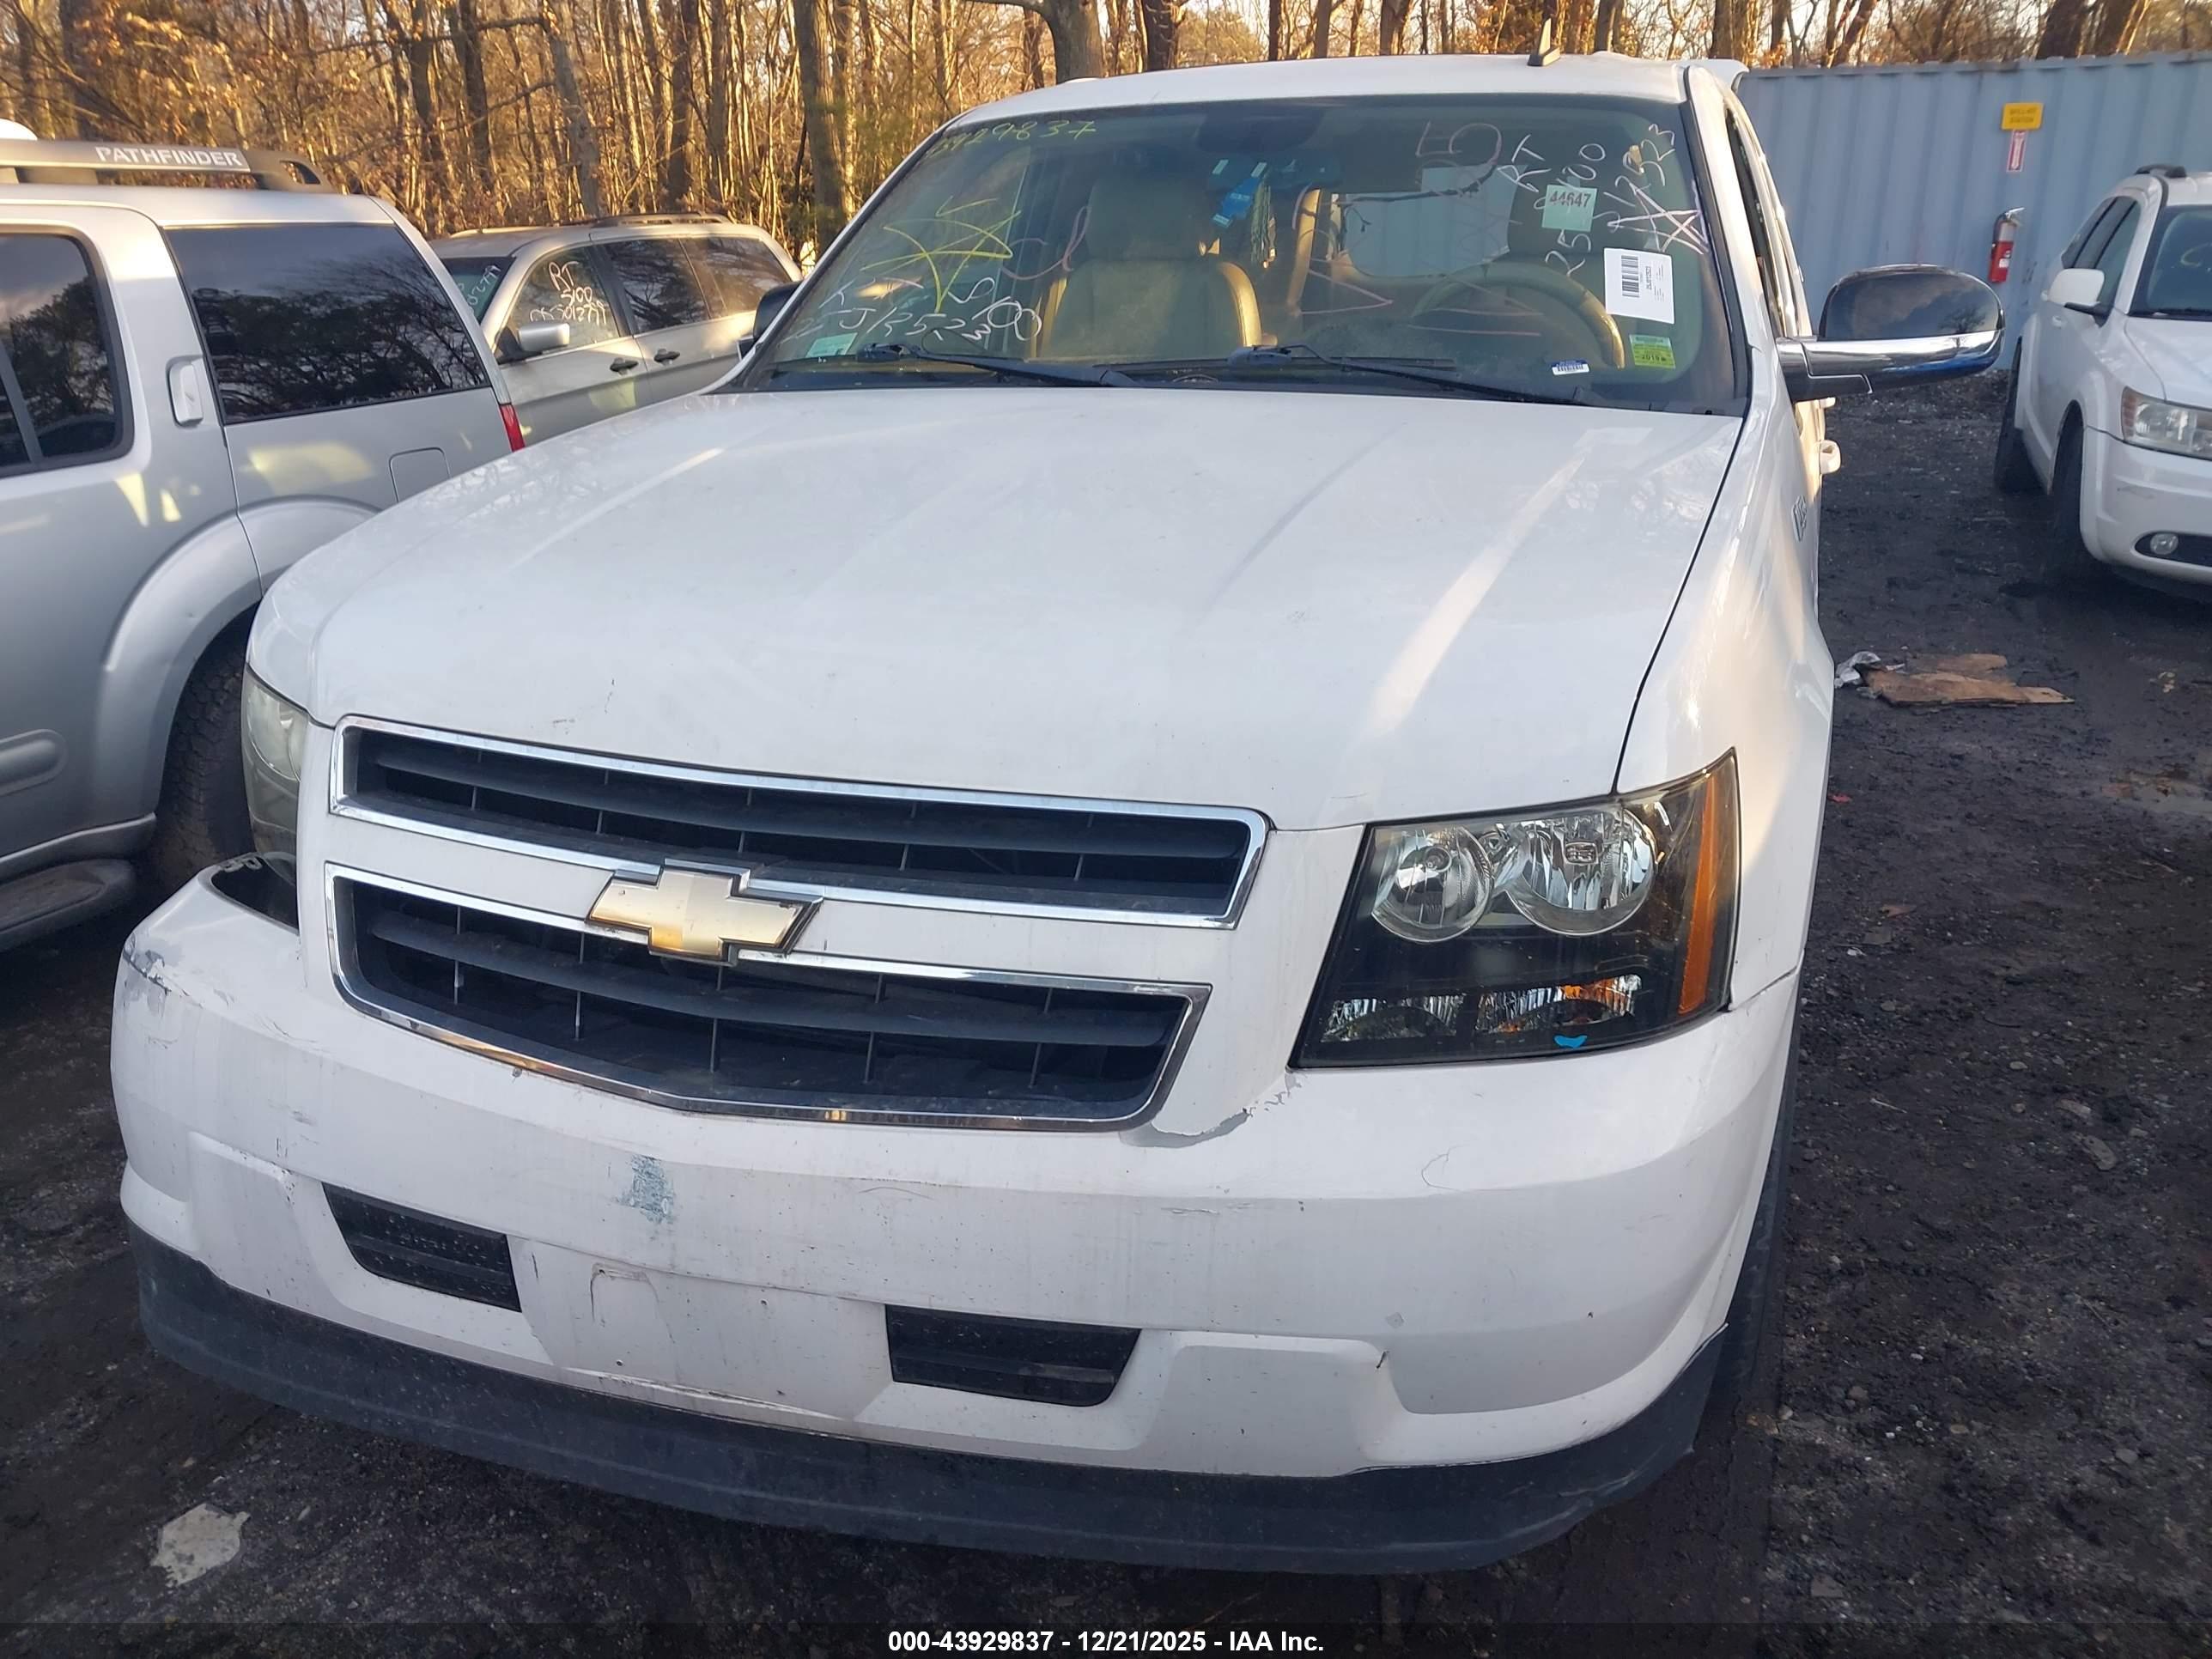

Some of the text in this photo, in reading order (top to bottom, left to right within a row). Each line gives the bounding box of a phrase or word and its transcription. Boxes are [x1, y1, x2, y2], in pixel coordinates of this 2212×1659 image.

[94, 146, 243, 167] PATHFINDER
[1549, 190, 1592, 209] 44647
[548, 261, 580, 291] RT
